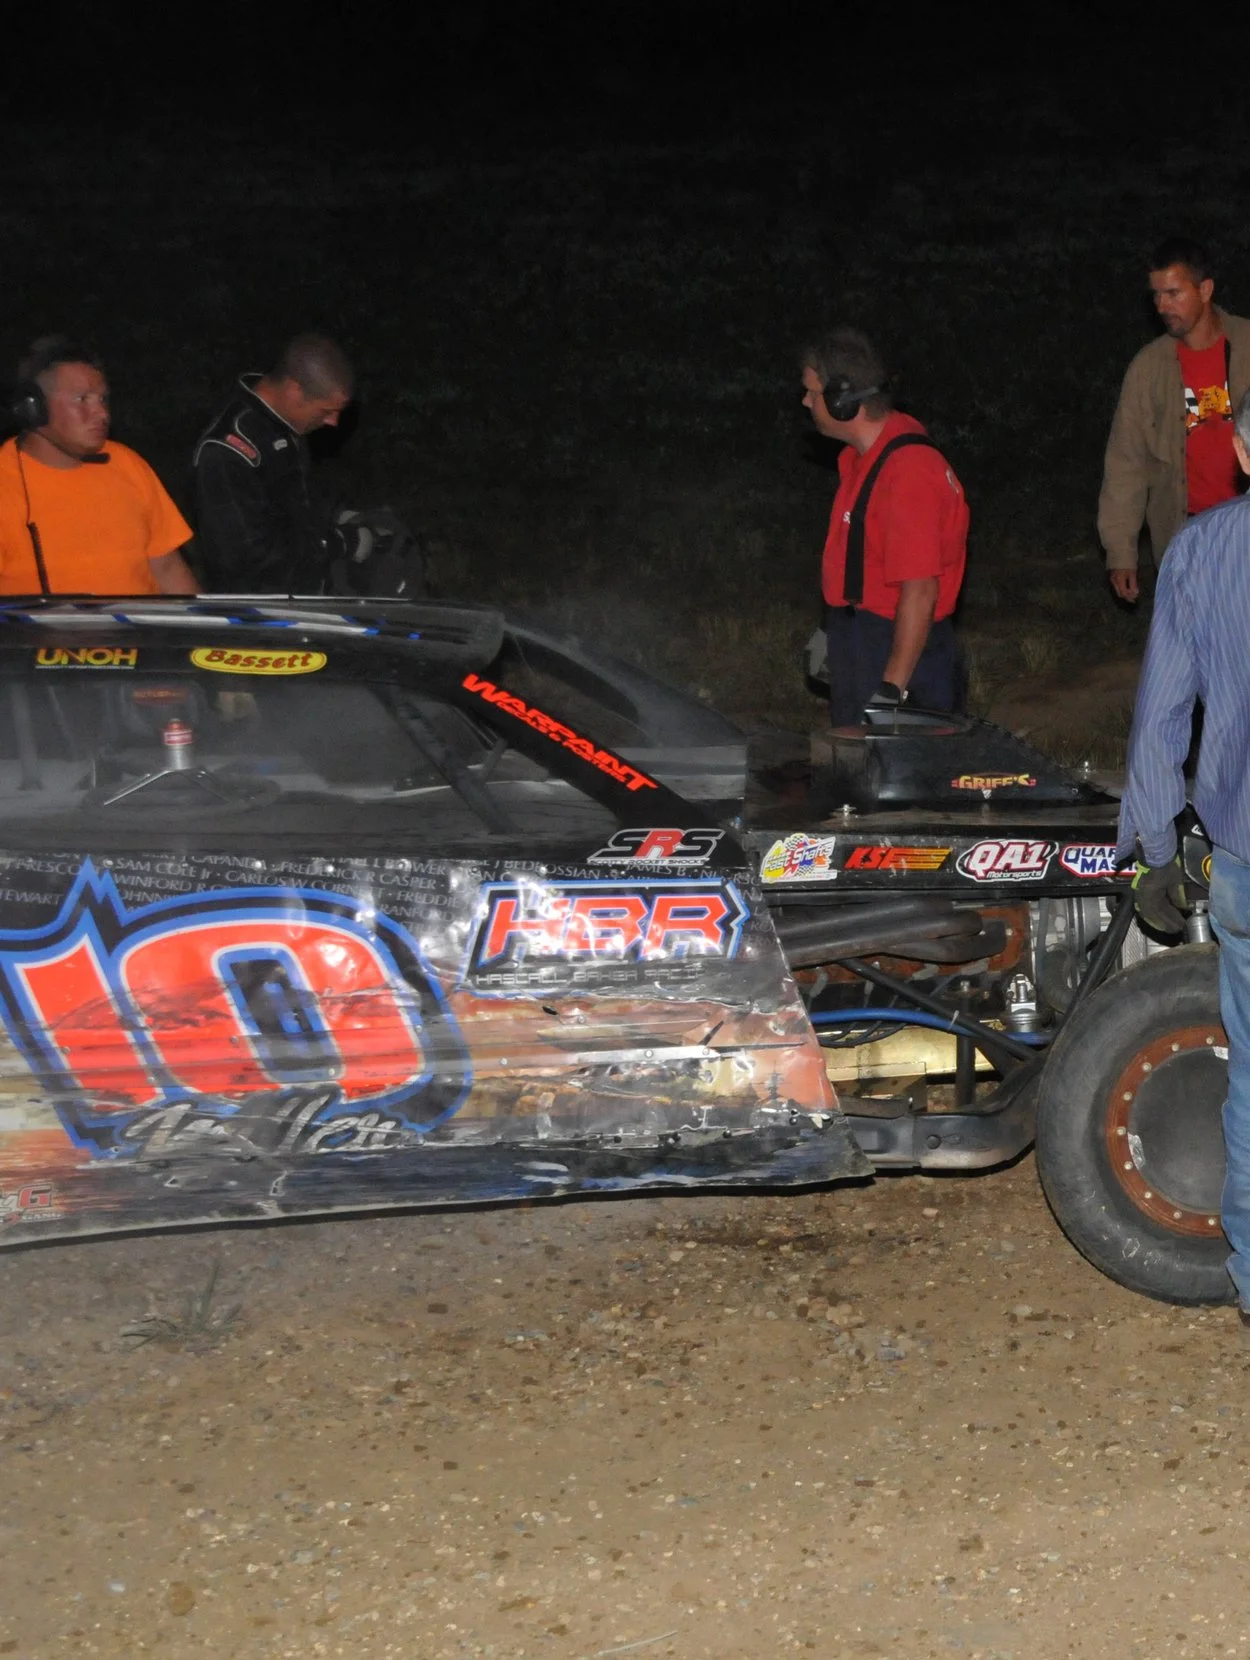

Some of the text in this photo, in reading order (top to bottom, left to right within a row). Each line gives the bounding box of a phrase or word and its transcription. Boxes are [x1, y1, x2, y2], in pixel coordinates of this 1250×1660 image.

[36, 648, 138, 665] UNOH
[204, 650, 312, 669] Bassett
[462, 673, 658, 791] WARPAINT
[957, 773, 1030, 790] GRIFF'S
[587, 828, 725, 860] SRS
[1065, 845, 1117, 864] QUAR
[765, 842, 835, 872] Fast Shafts
[967, 841, 1050, 879] QA1
[114, 873, 192, 892] WINFORD
[115, 858, 151, 872] SAM
[224, 870, 287, 888] CARLOS
[380, 873, 436, 889] CASPER
[986, 870, 1043, 879] Motorsports
[485, 894, 730, 961] HBR
[15, 918, 426, 1112] 10
